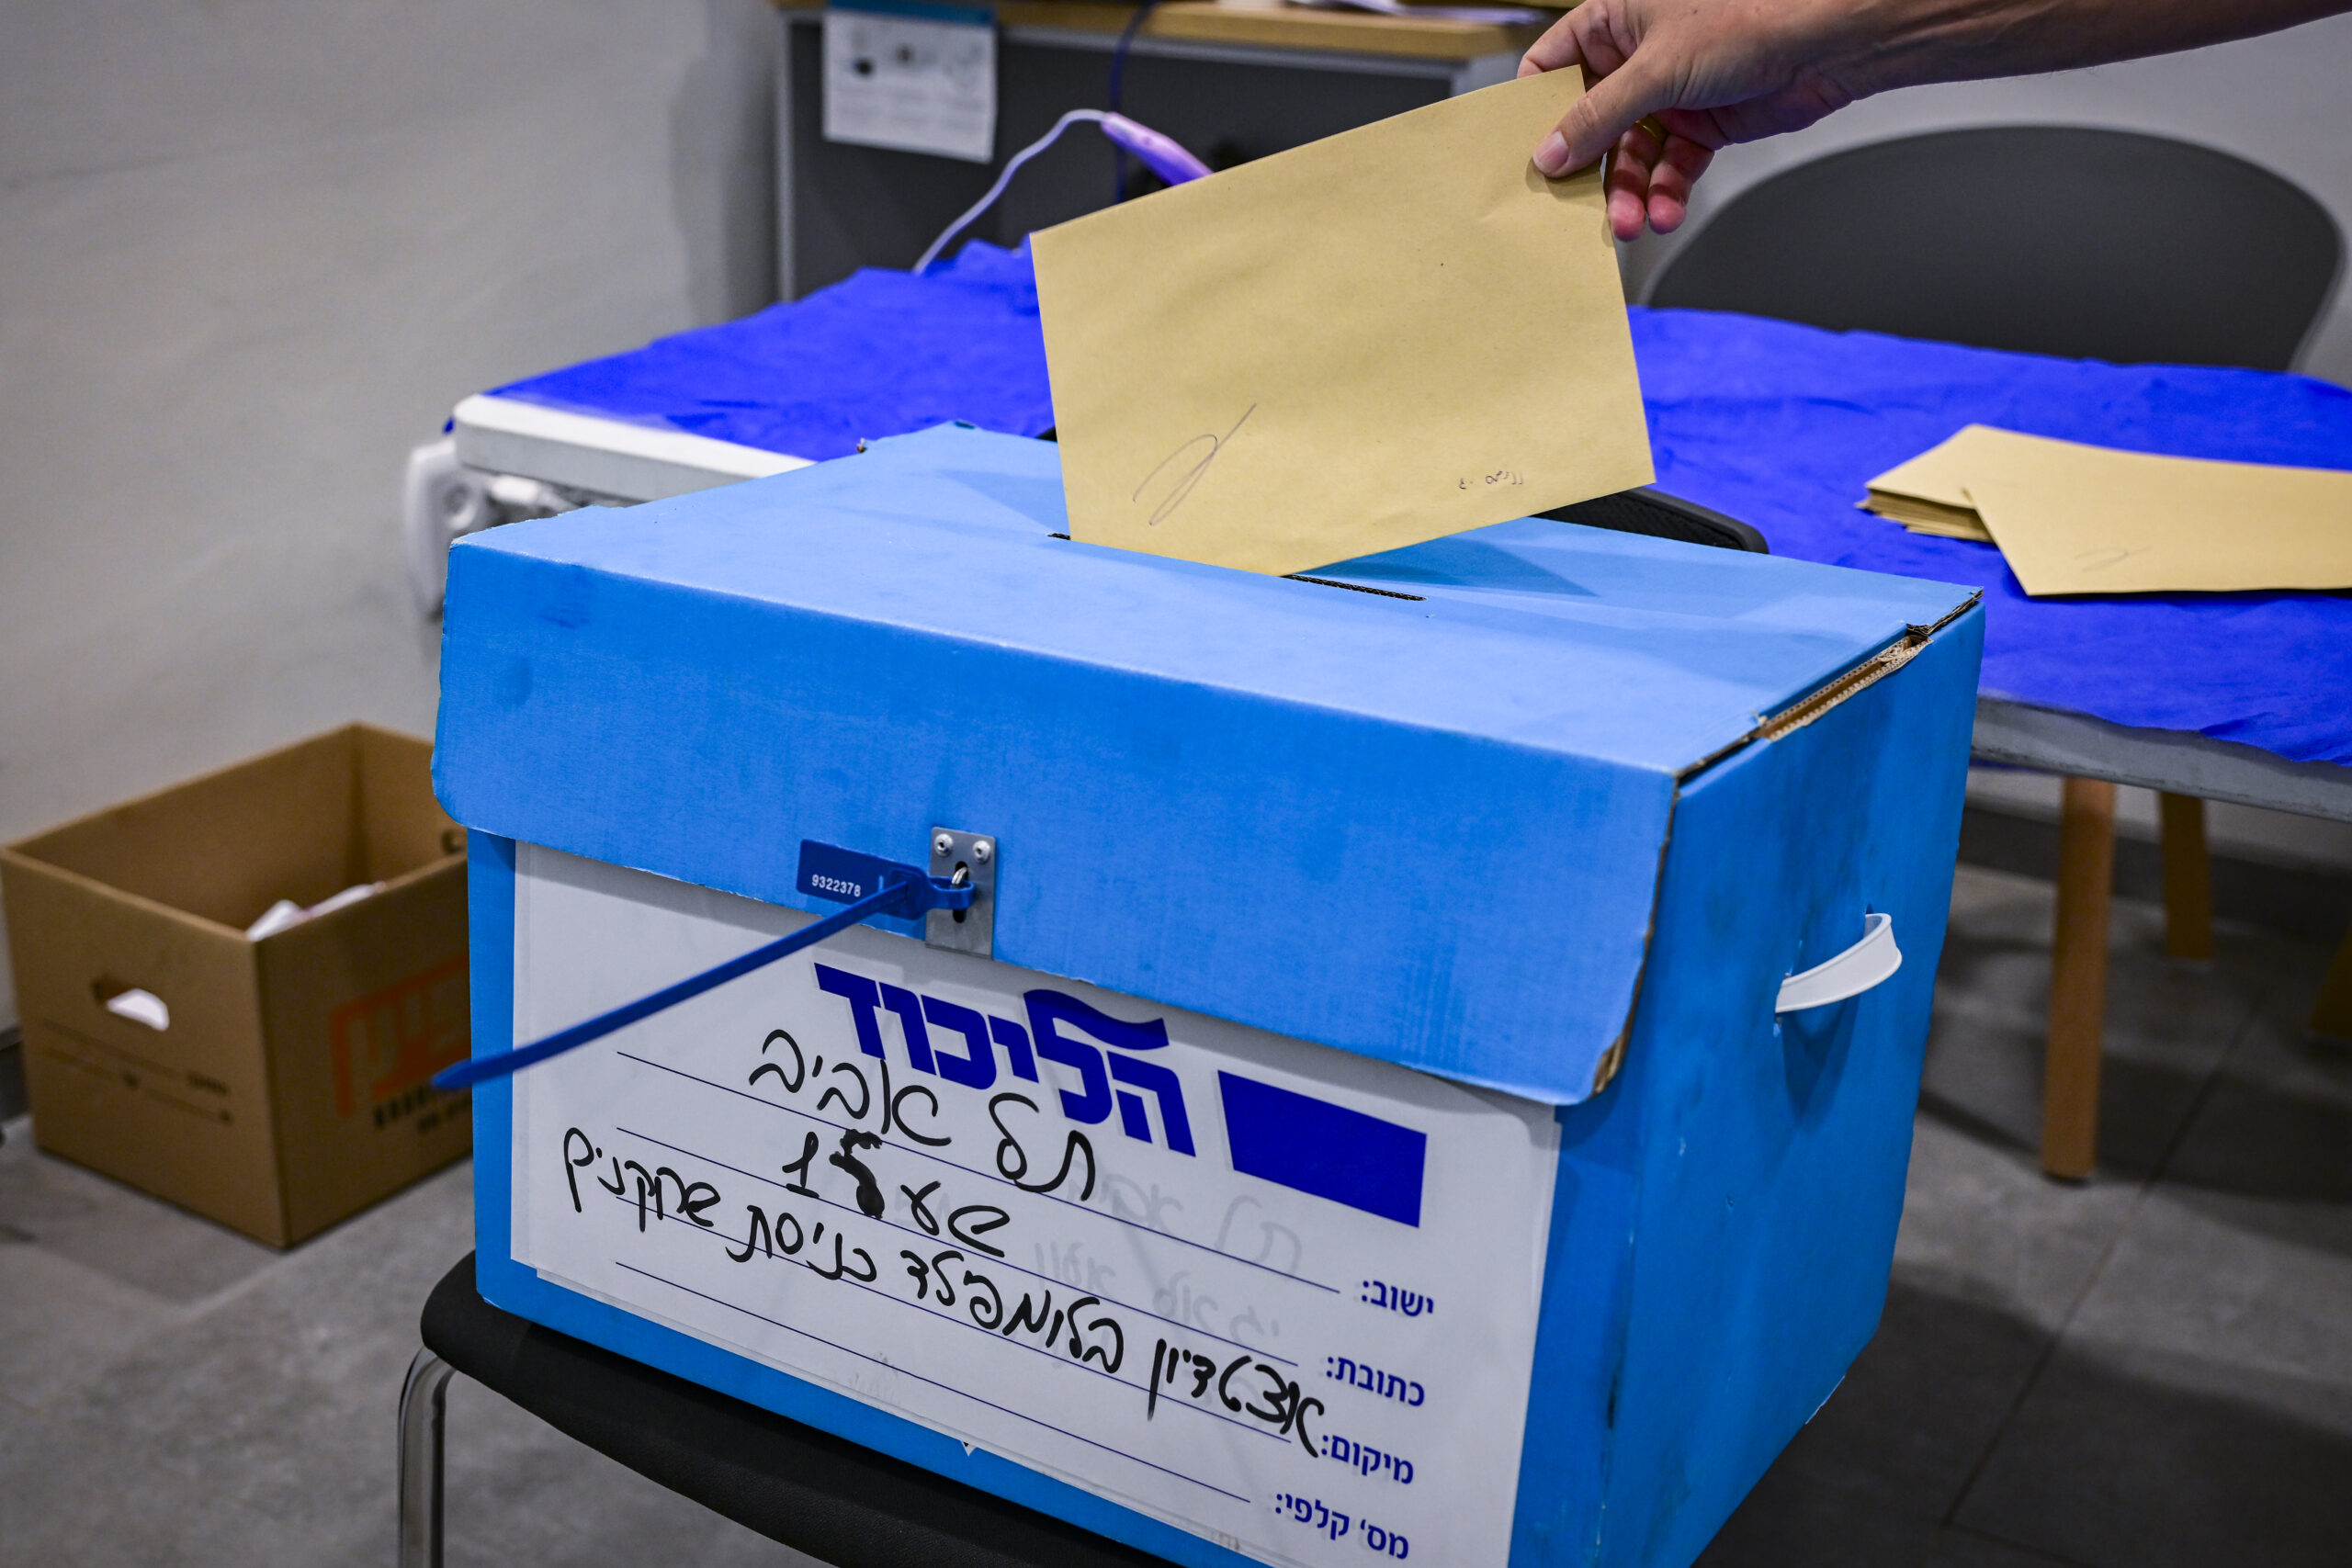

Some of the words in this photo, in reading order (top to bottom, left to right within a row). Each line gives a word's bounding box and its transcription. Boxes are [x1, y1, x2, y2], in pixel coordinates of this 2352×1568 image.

[811, 874, 862, 897] 9322378
[748, 1029, 953, 1147] אביב
[813, 962, 1197, 1158] הליכוד
[563, 1127, 721, 1234] שחקנים
[988, 1092, 1097, 1201] תל
[725, 1204, 877, 1282] כניסת
[900, 1249, 1125, 1374] בלומפלד
[1362, 1280, 1434, 1317] ישוב:
[1326, 1356, 1425, 1407] כתובת:
[1321, 1434, 1414, 1485] מיקום:
[1275, 1493, 1351, 1541] קלפי:
